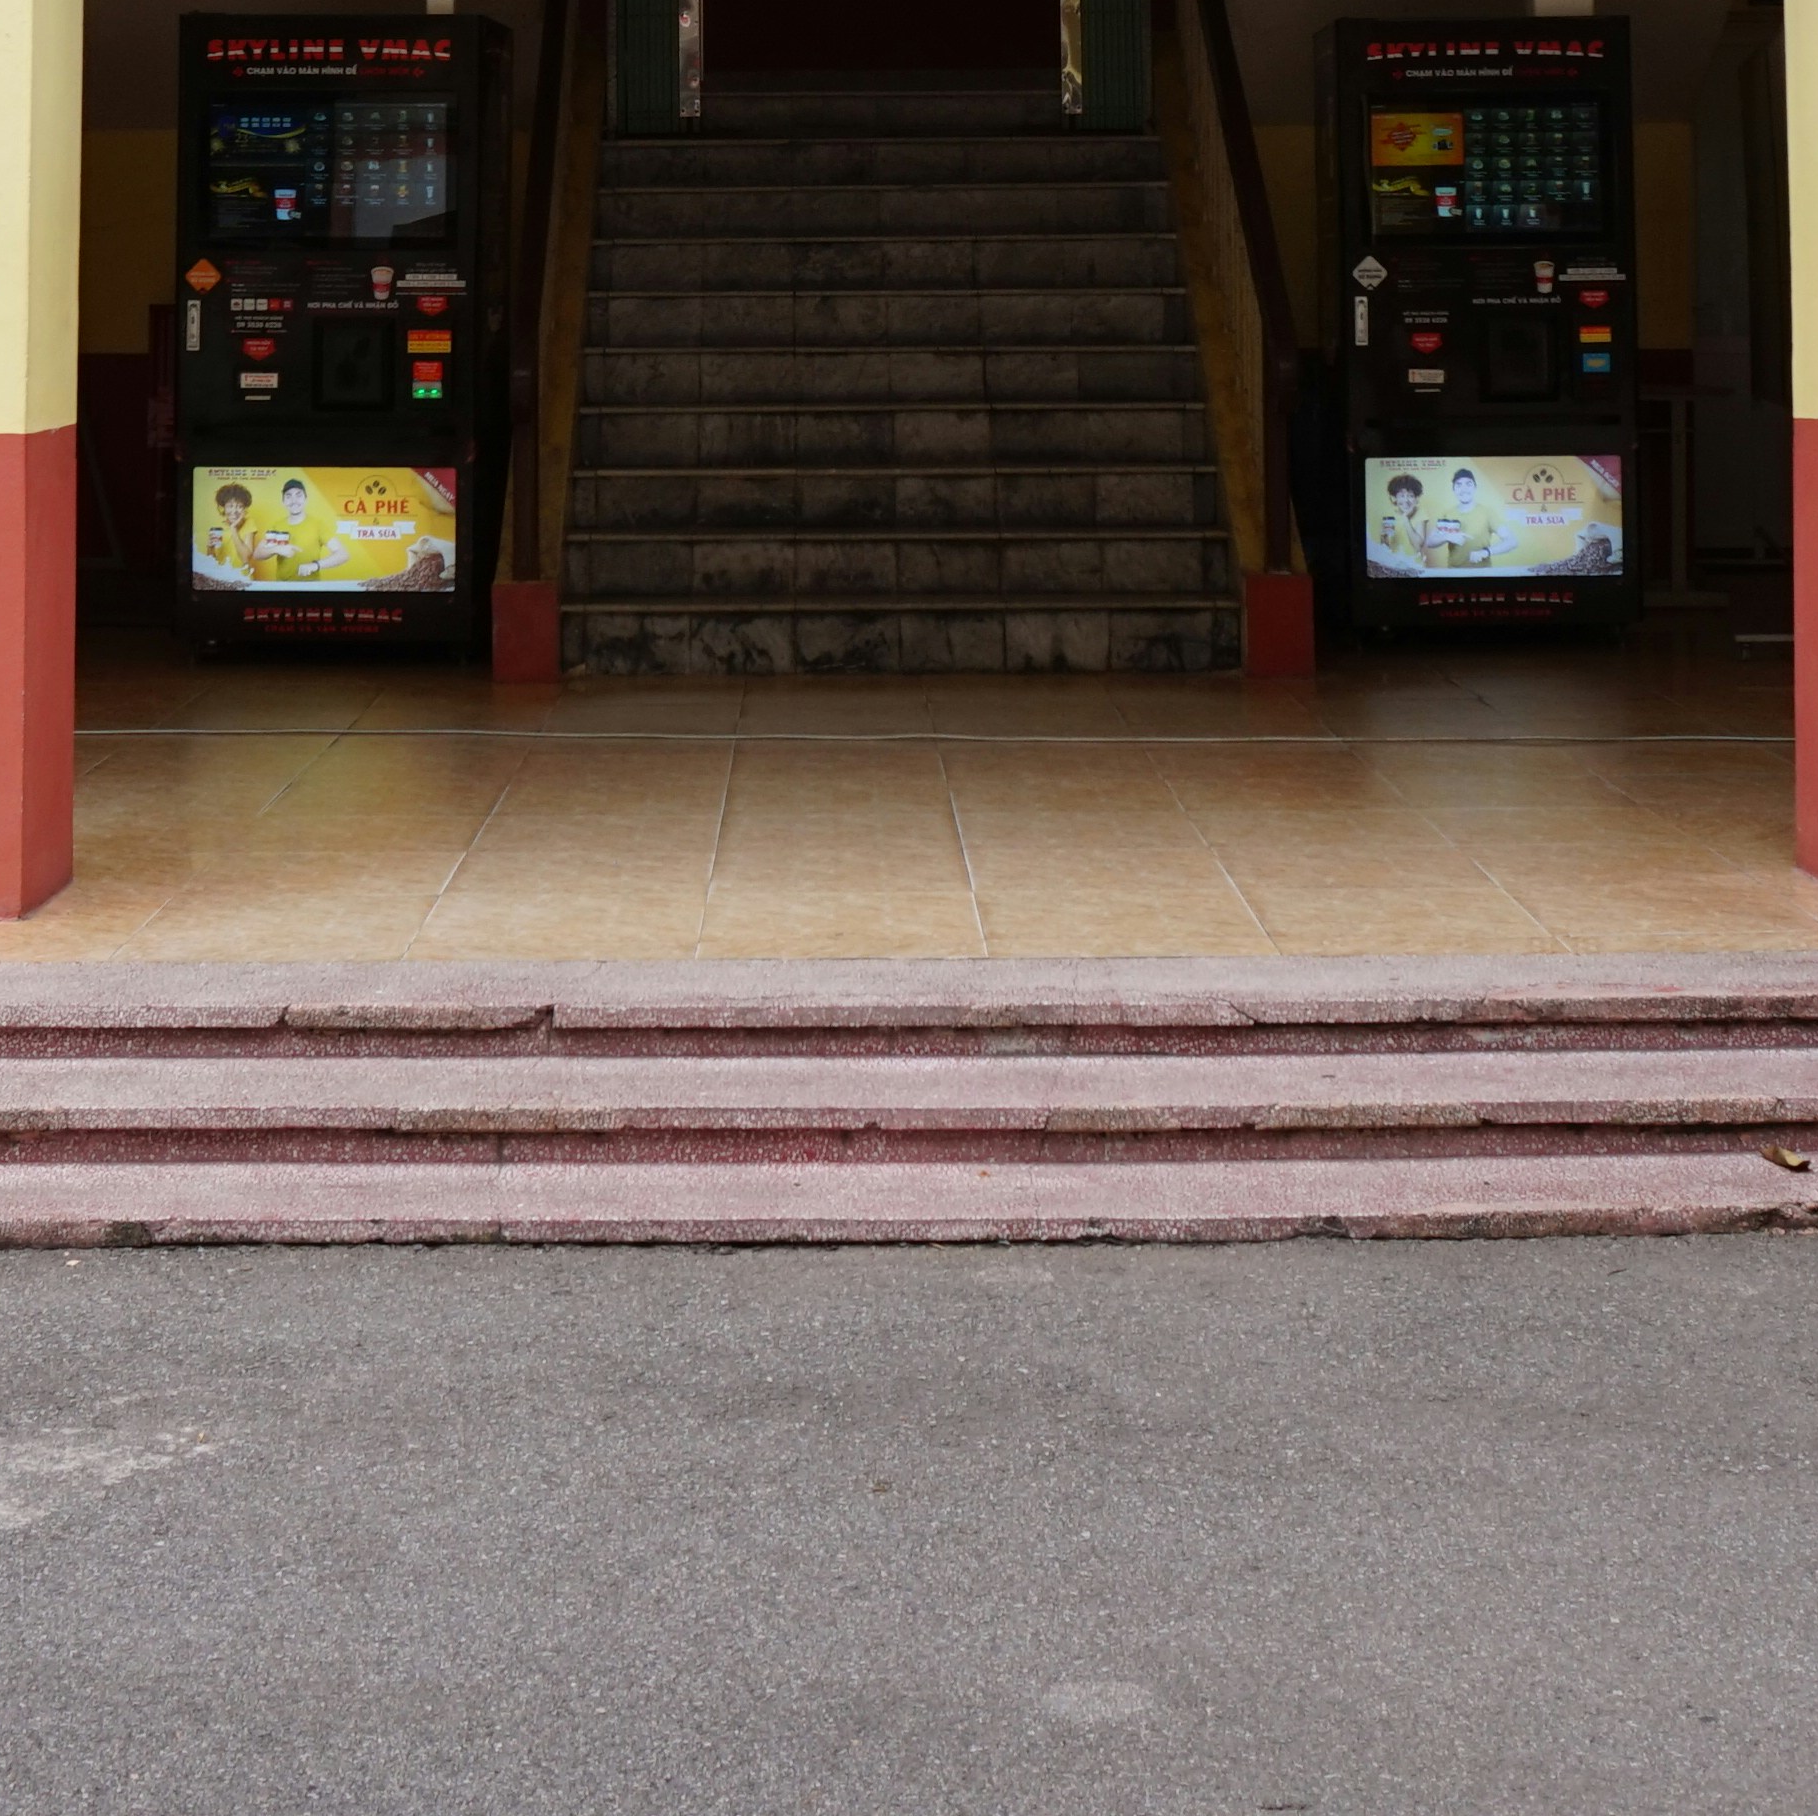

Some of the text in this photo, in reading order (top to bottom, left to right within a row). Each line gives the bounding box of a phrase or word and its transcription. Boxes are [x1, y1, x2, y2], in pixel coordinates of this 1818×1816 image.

[206, 39, 452, 61] SKYLINE VMAC
[1513, 40, 1605, 59] VMAC
[424, 471, 456, 502] MUA NGAY
[1513, 486, 1535, 501] CÀ
[344, 497, 410, 514] CÀ PHÊ
[243, 607, 405, 623] SKYLINE VMAC
